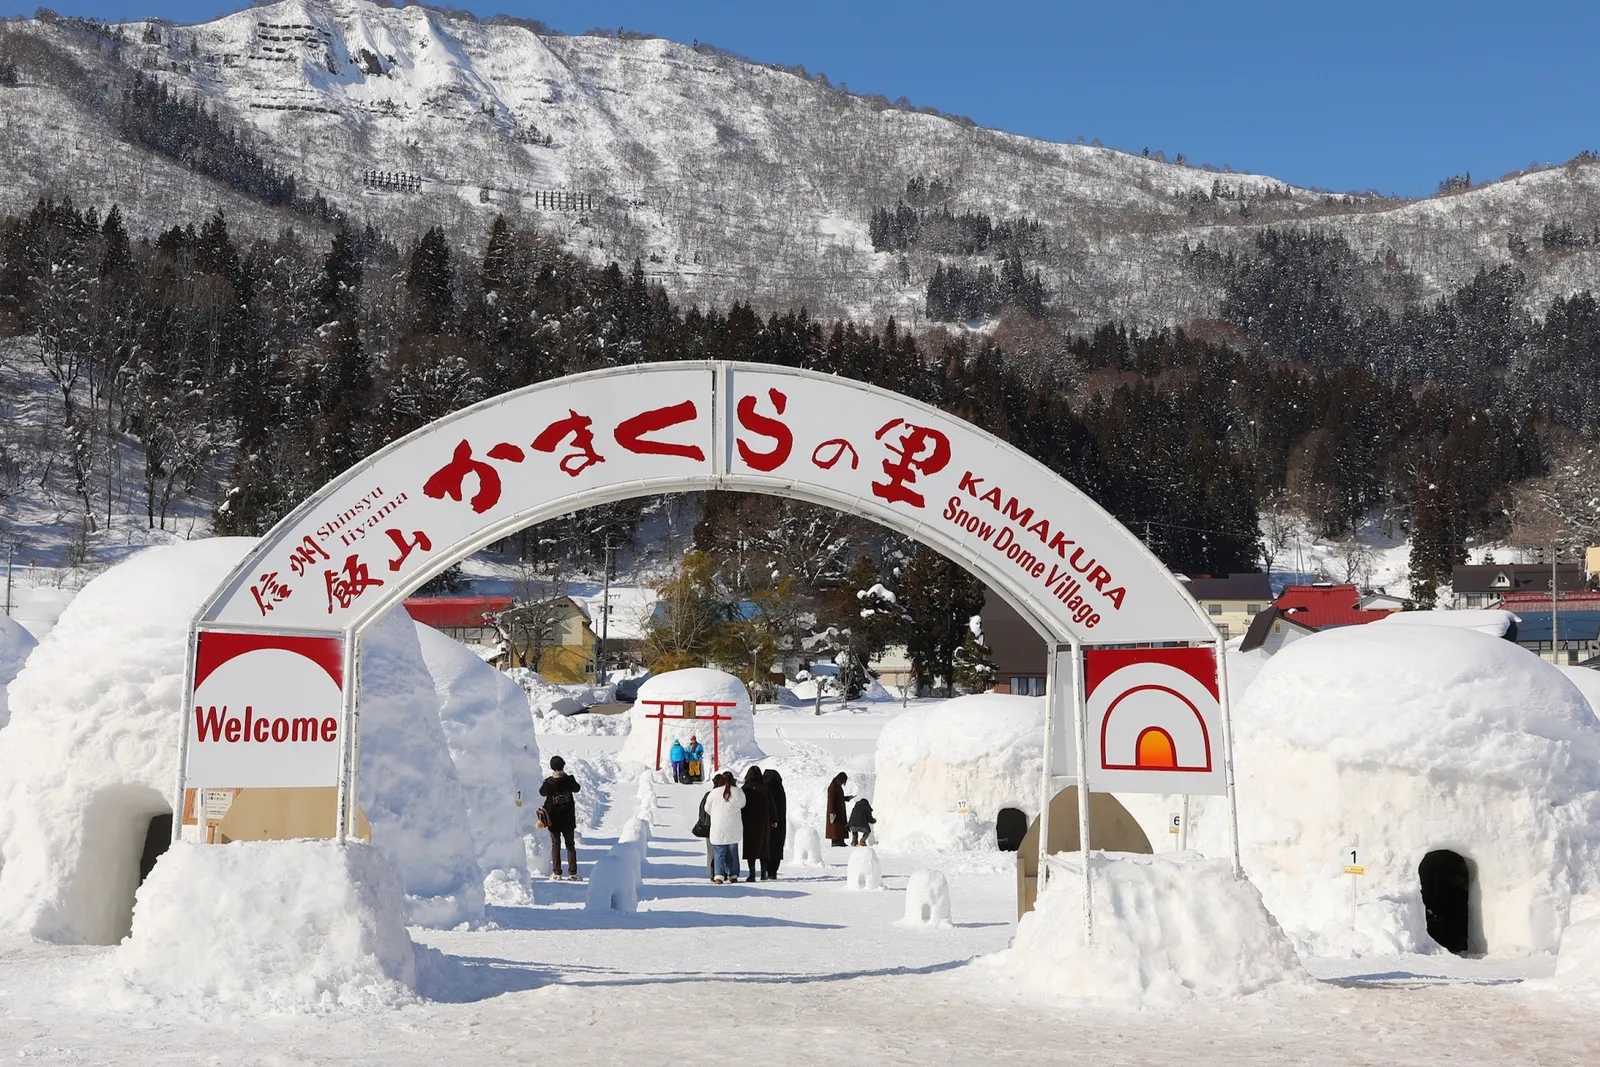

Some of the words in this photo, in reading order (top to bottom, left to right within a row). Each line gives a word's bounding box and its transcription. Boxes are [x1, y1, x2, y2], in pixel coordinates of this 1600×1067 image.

[316, 486, 384, 541] Shinsyu
[339, 491, 409, 547] Iiyama
[958, 470, 1127, 611] KAMAKURA
[323, 528, 433, 614] 飯山
[942, 495, 997, 542] Snow
[992, 526, 1046, 579] Dome
[1044, 563, 1101, 629] Village
[195, 705, 338, 744] Welcome
[1350, 850, 1357, 864] 1
